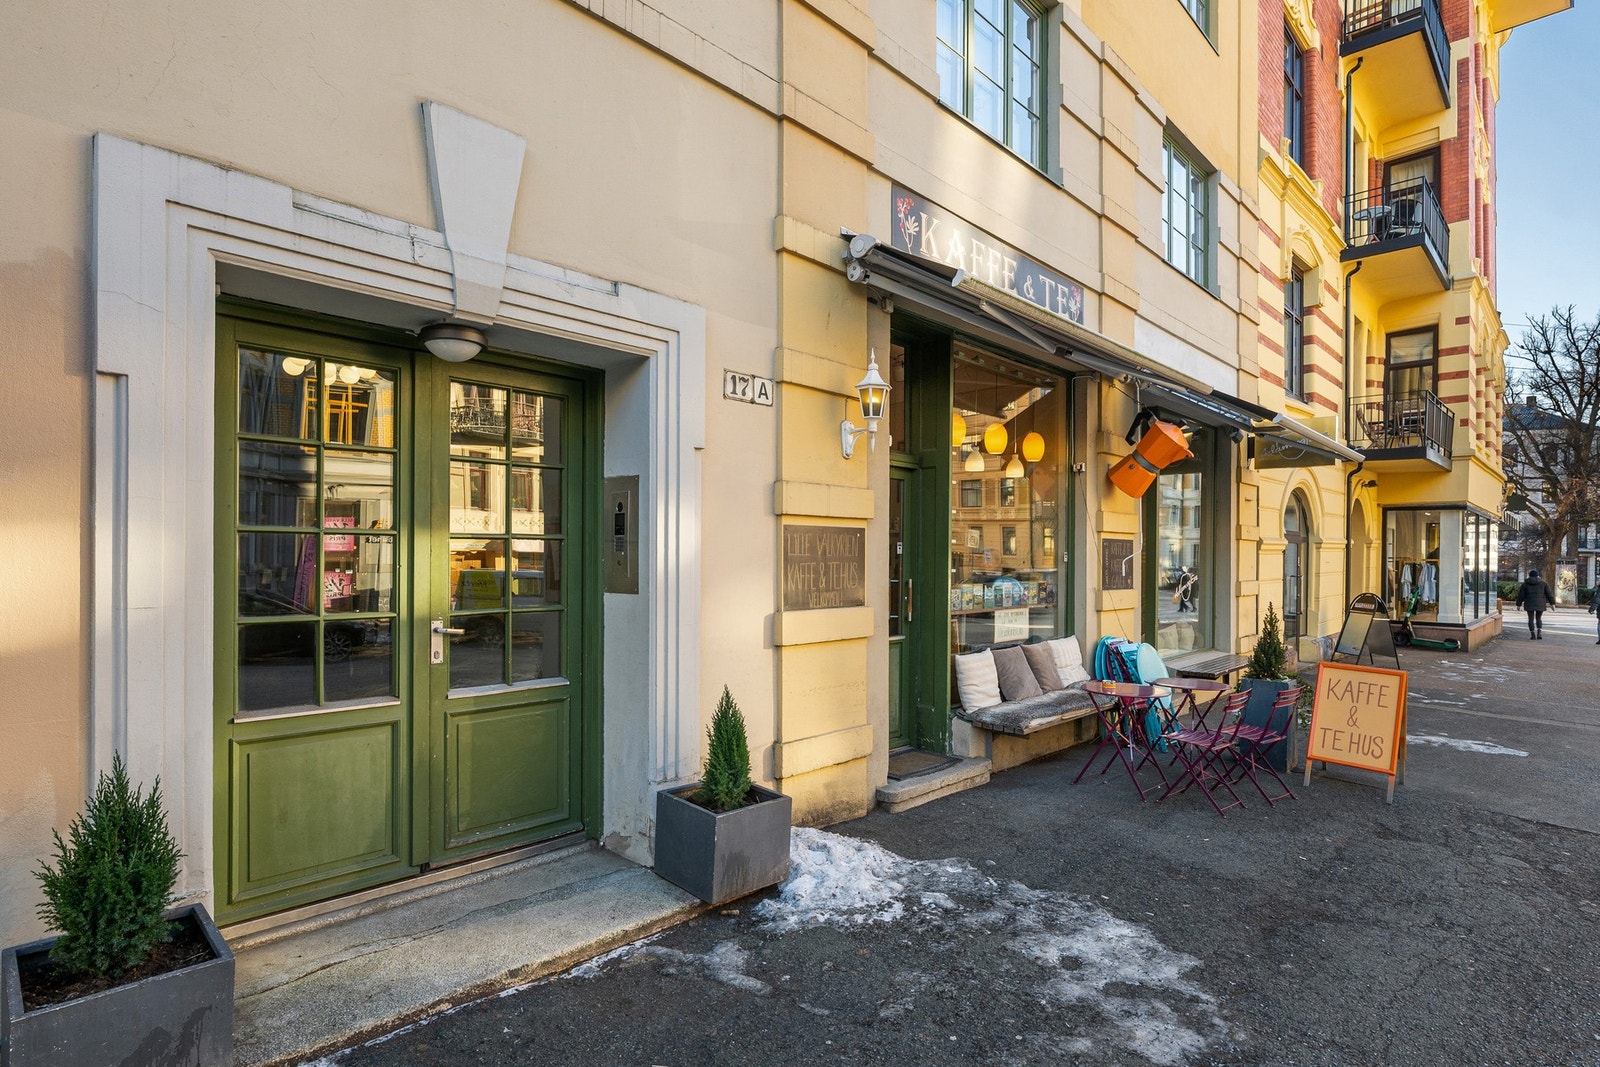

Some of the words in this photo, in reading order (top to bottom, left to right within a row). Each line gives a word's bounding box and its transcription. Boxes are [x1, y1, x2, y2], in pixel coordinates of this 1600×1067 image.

[920, 212, 1018, 295] KAFFE
[1023, 275, 1036, 301] &
[1039, 274, 1070, 319] TE
[730, 374, 750, 397] 17
[757, 381, 770, 400] A
[787, 562, 817, 591] KAFFE
[818, 561, 826, 588] &
[828, 561, 858, 589] TEHUS
[1326, 677, 1390, 709] KAFFE
[1346, 705, 1360, 729] &
